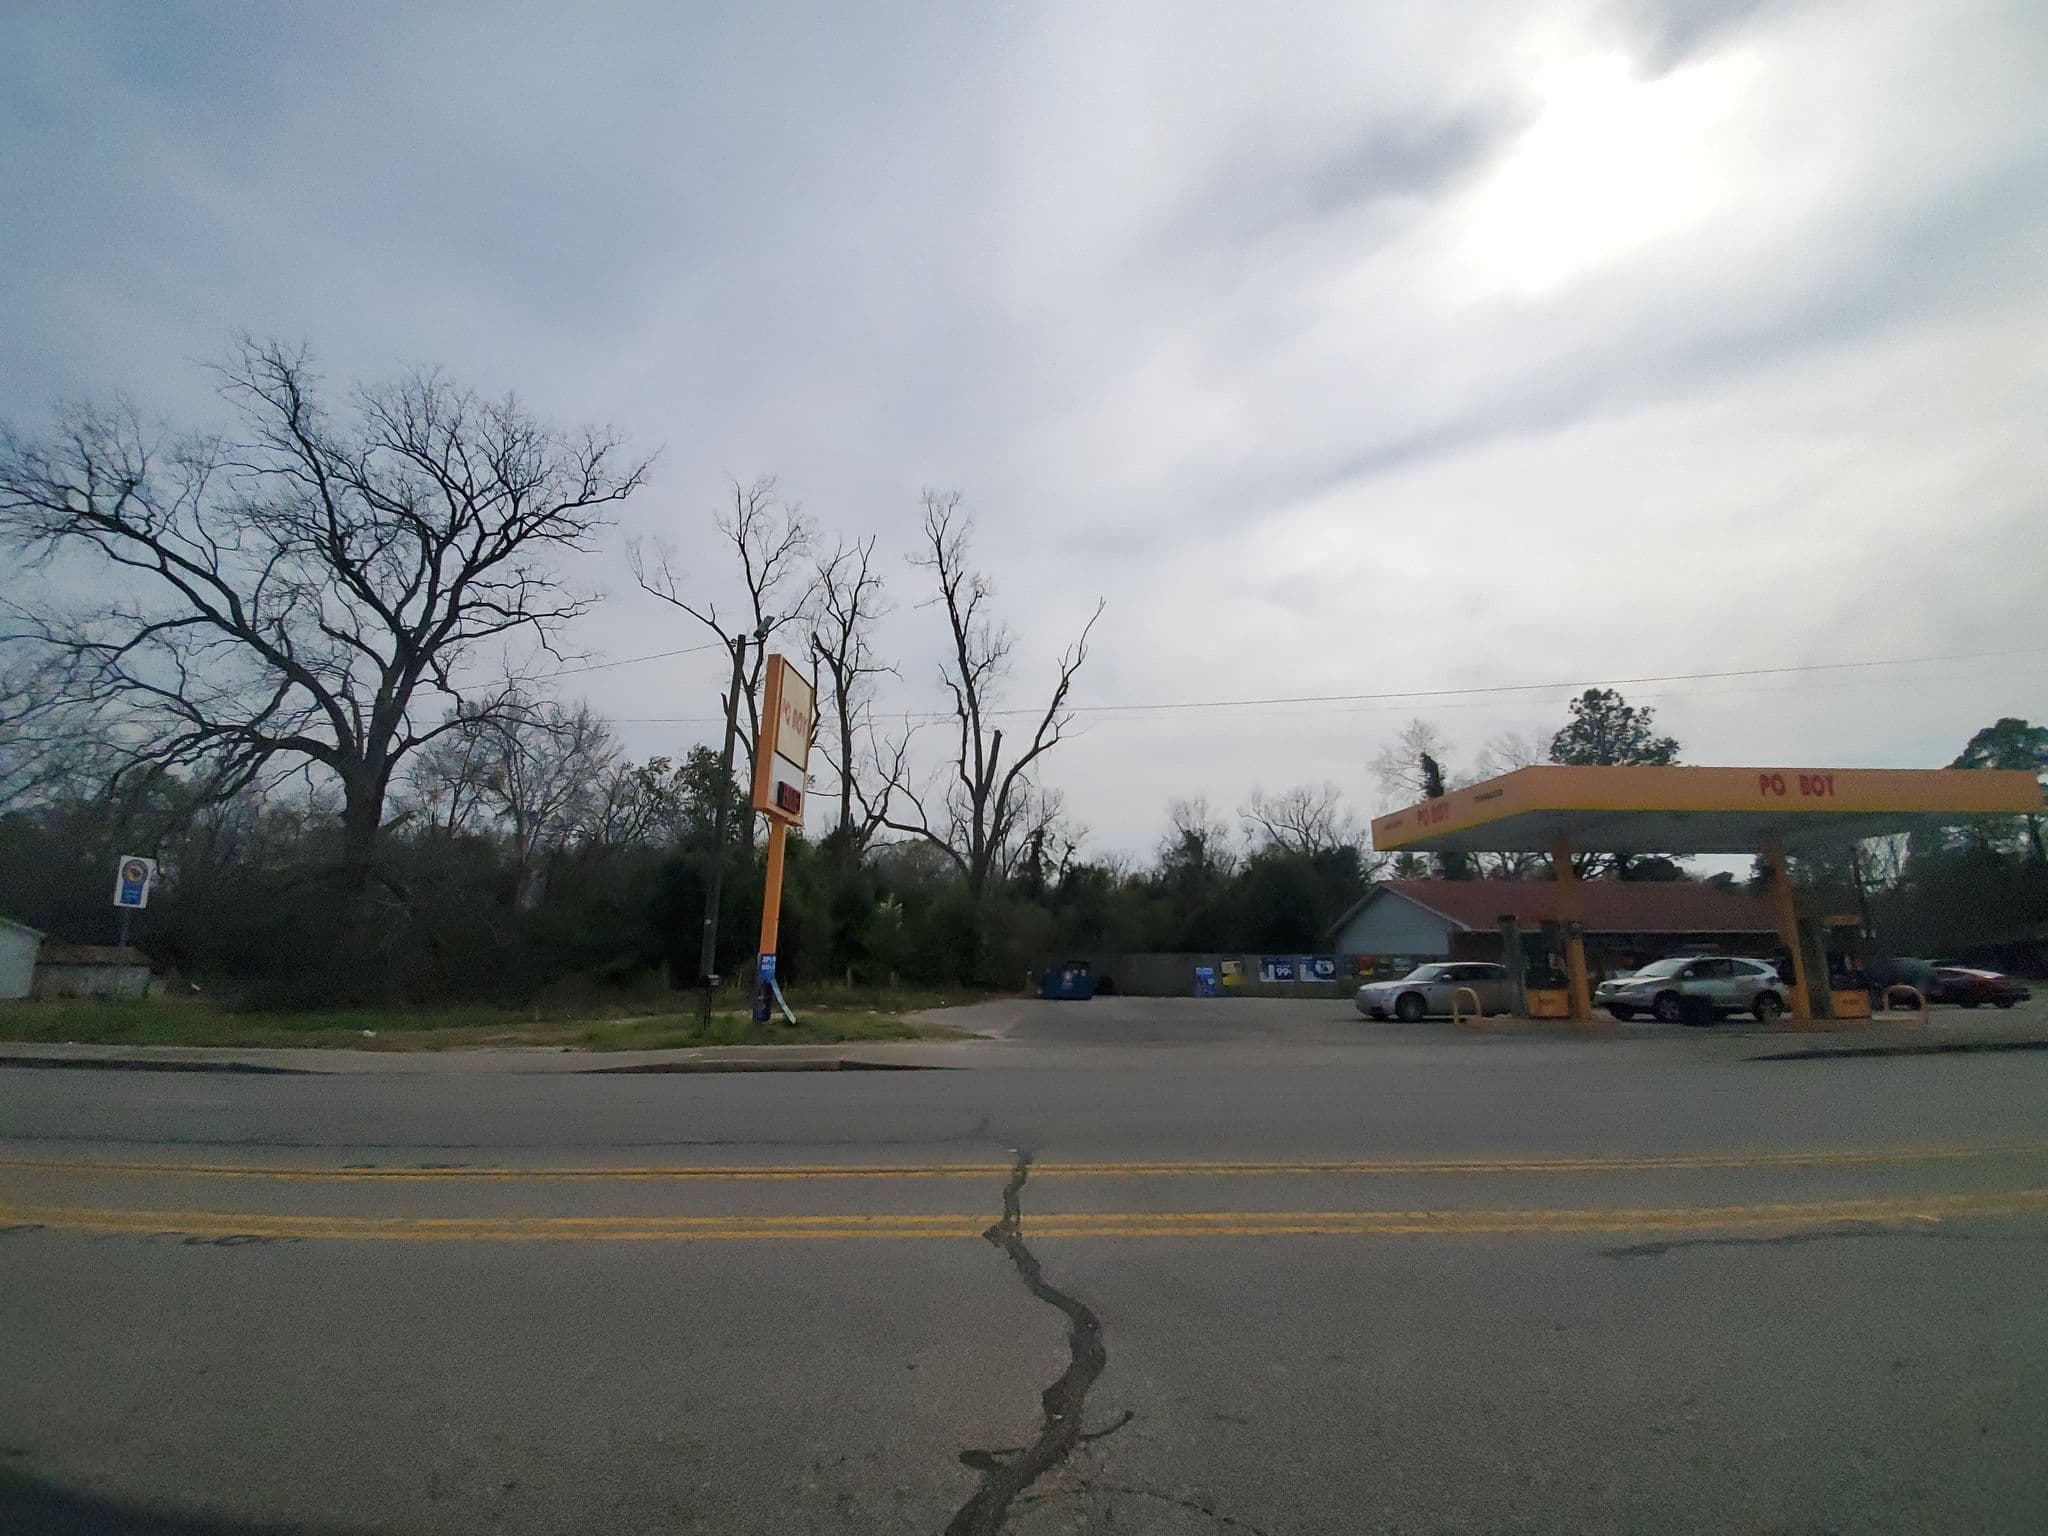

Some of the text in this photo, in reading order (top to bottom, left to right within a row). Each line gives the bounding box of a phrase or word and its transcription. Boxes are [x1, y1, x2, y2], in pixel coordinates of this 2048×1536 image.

[792, 708, 808, 738] BOY
[1759, 774, 1834, 796] PO BOY
[1430, 803, 1448, 824] BOY
